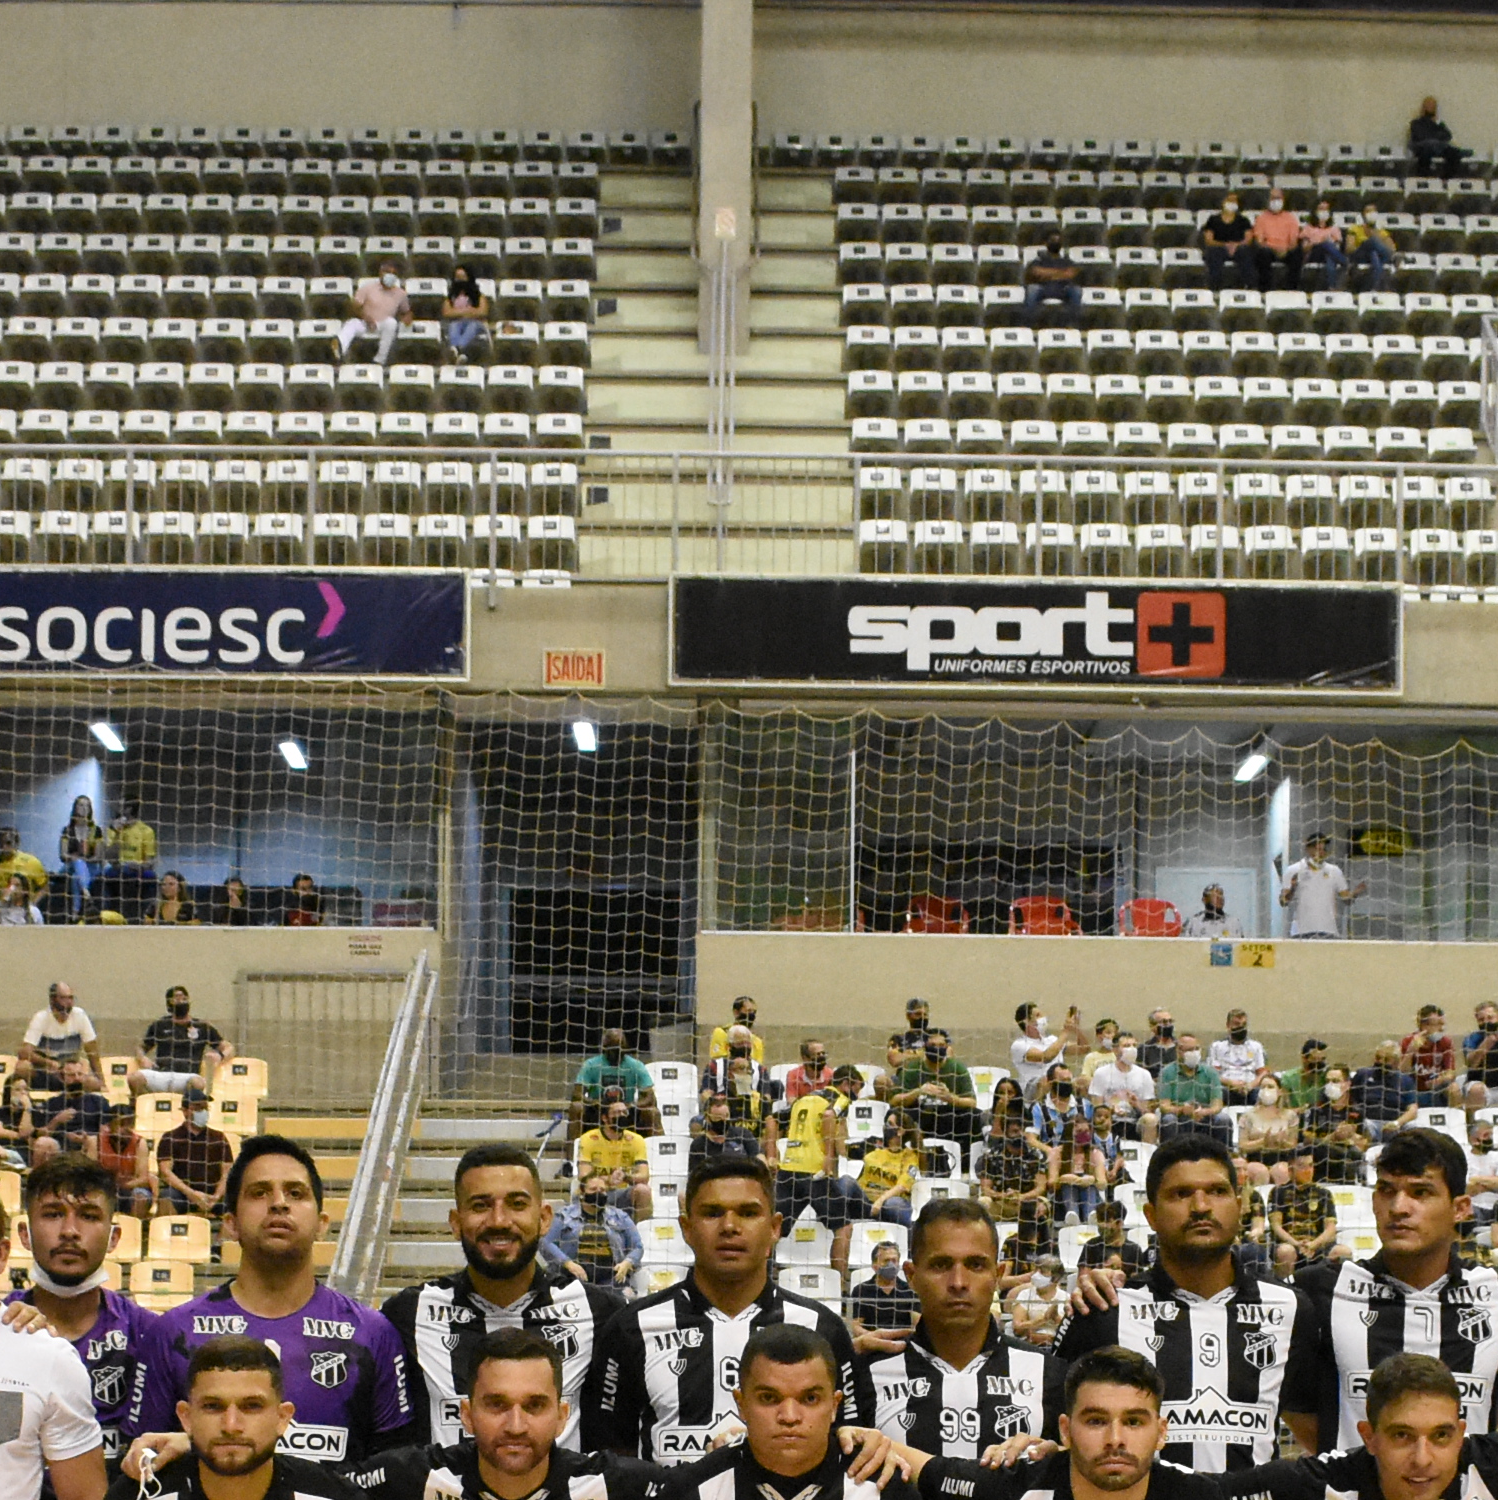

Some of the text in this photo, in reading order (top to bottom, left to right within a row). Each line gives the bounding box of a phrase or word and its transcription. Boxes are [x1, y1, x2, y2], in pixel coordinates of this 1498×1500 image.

[552, 651, 595, 681] SAÍDA
[934, 659, 1131, 675] UNIFORMES ESPORTIVOS
[1413, 1306, 1435, 1343] 7
[1199, 1332, 1221, 1369] 9
[129, 1361, 148, 1423] ILUMI
[394, 1354, 410, 1414] ILUMI
[601, 1357, 621, 1412] ILUMI
[840, 1361, 859, 1420] ILUMI
[939, 1407, 981, 1443] 99
[1167, 1408, 1268, 1430] AMACON
[275, 1432, 341, 1453] ACON
[940, 1476, 975, 1498] ILUMI
